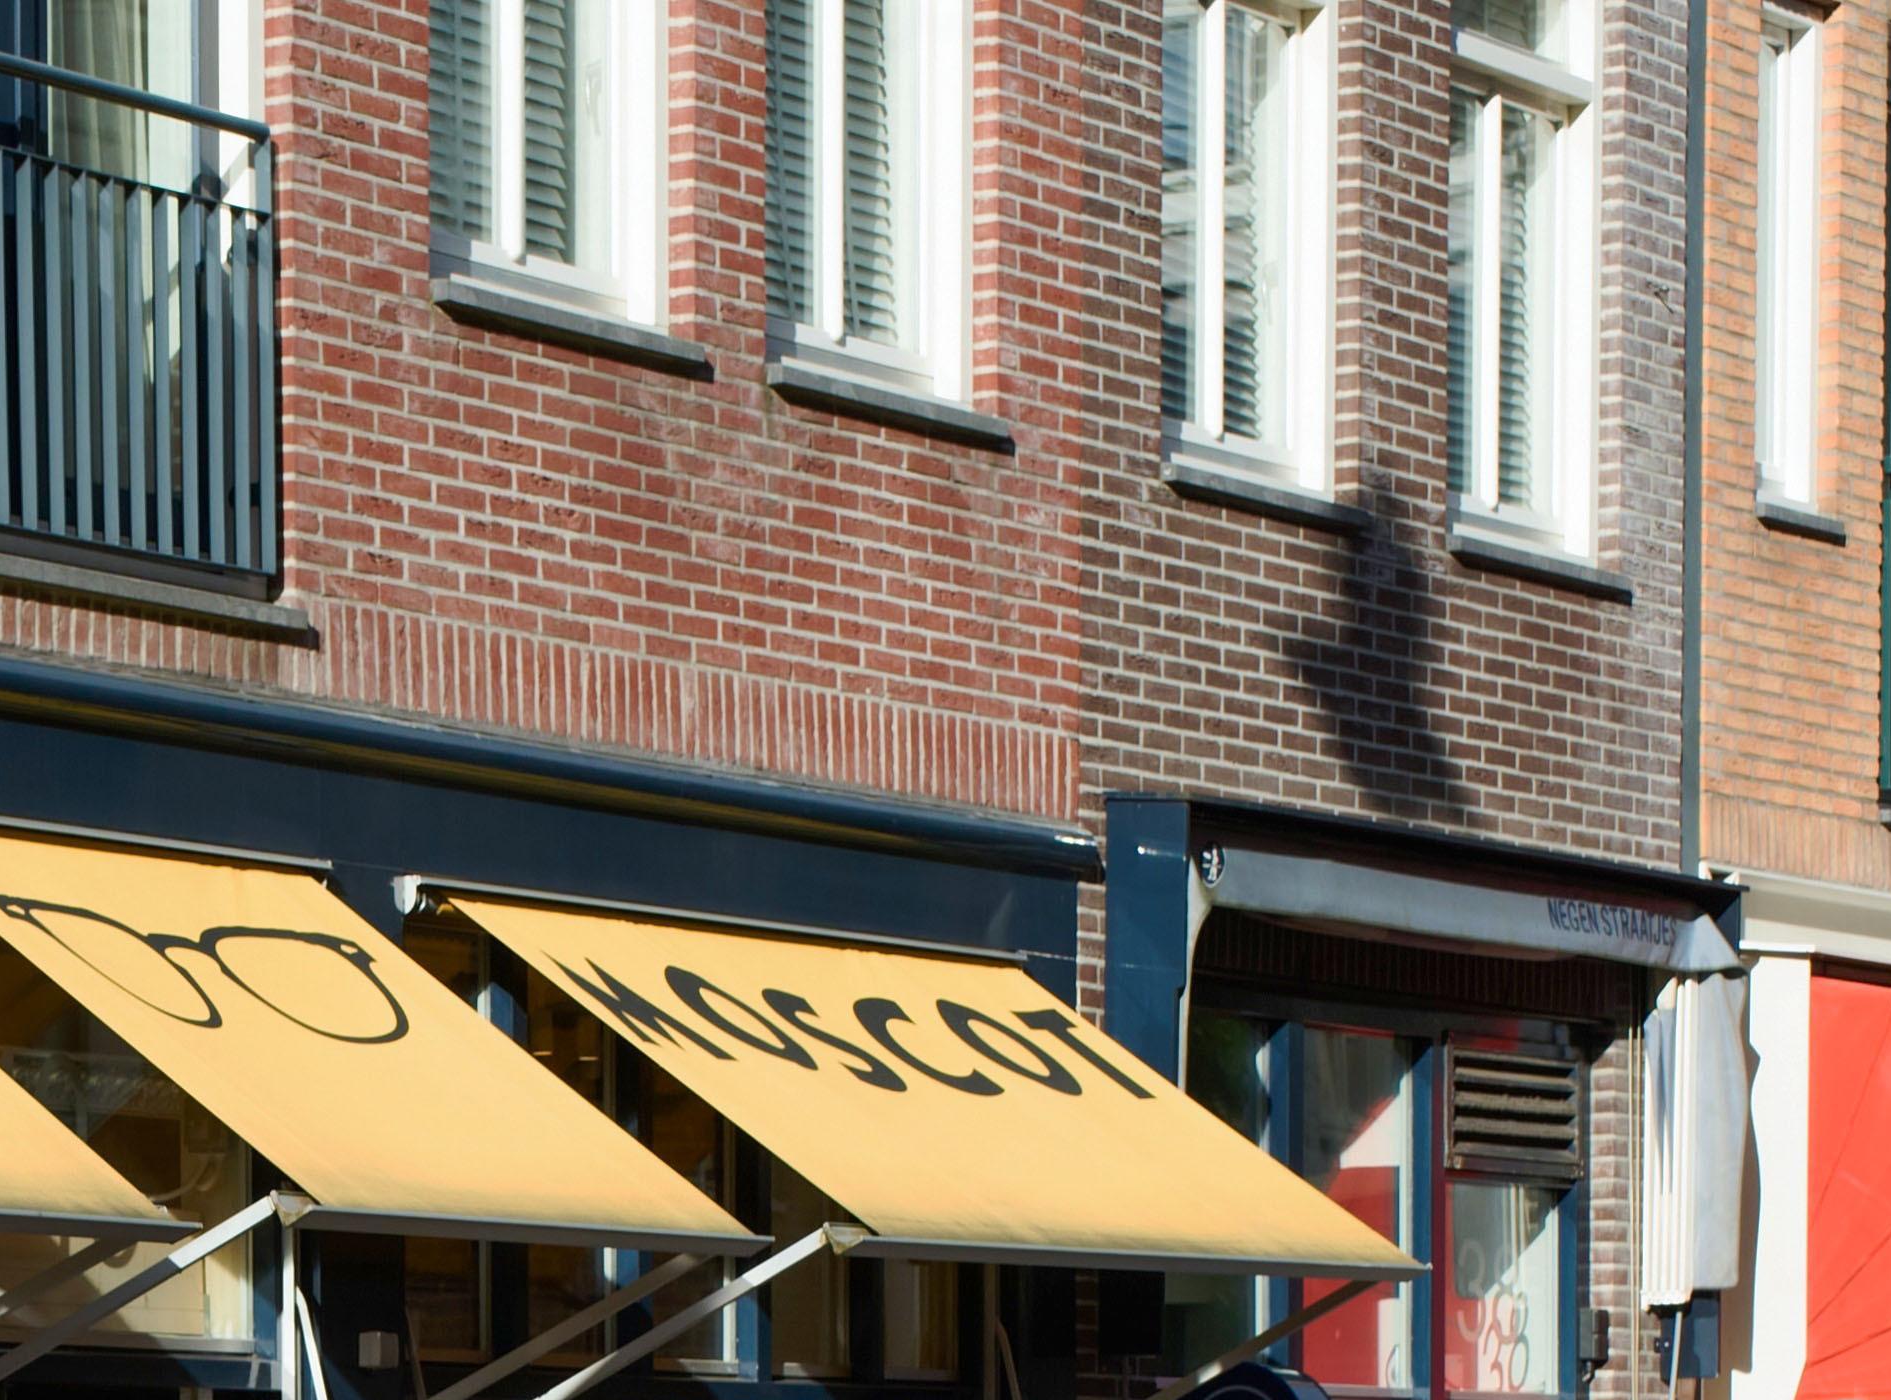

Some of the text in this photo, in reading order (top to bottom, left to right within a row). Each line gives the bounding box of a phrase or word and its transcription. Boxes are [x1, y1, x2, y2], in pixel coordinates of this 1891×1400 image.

[1547, 899, 1678, 947] NEGEN STRAATJES
[540, 950, 1157, 1100] MOSCOT
